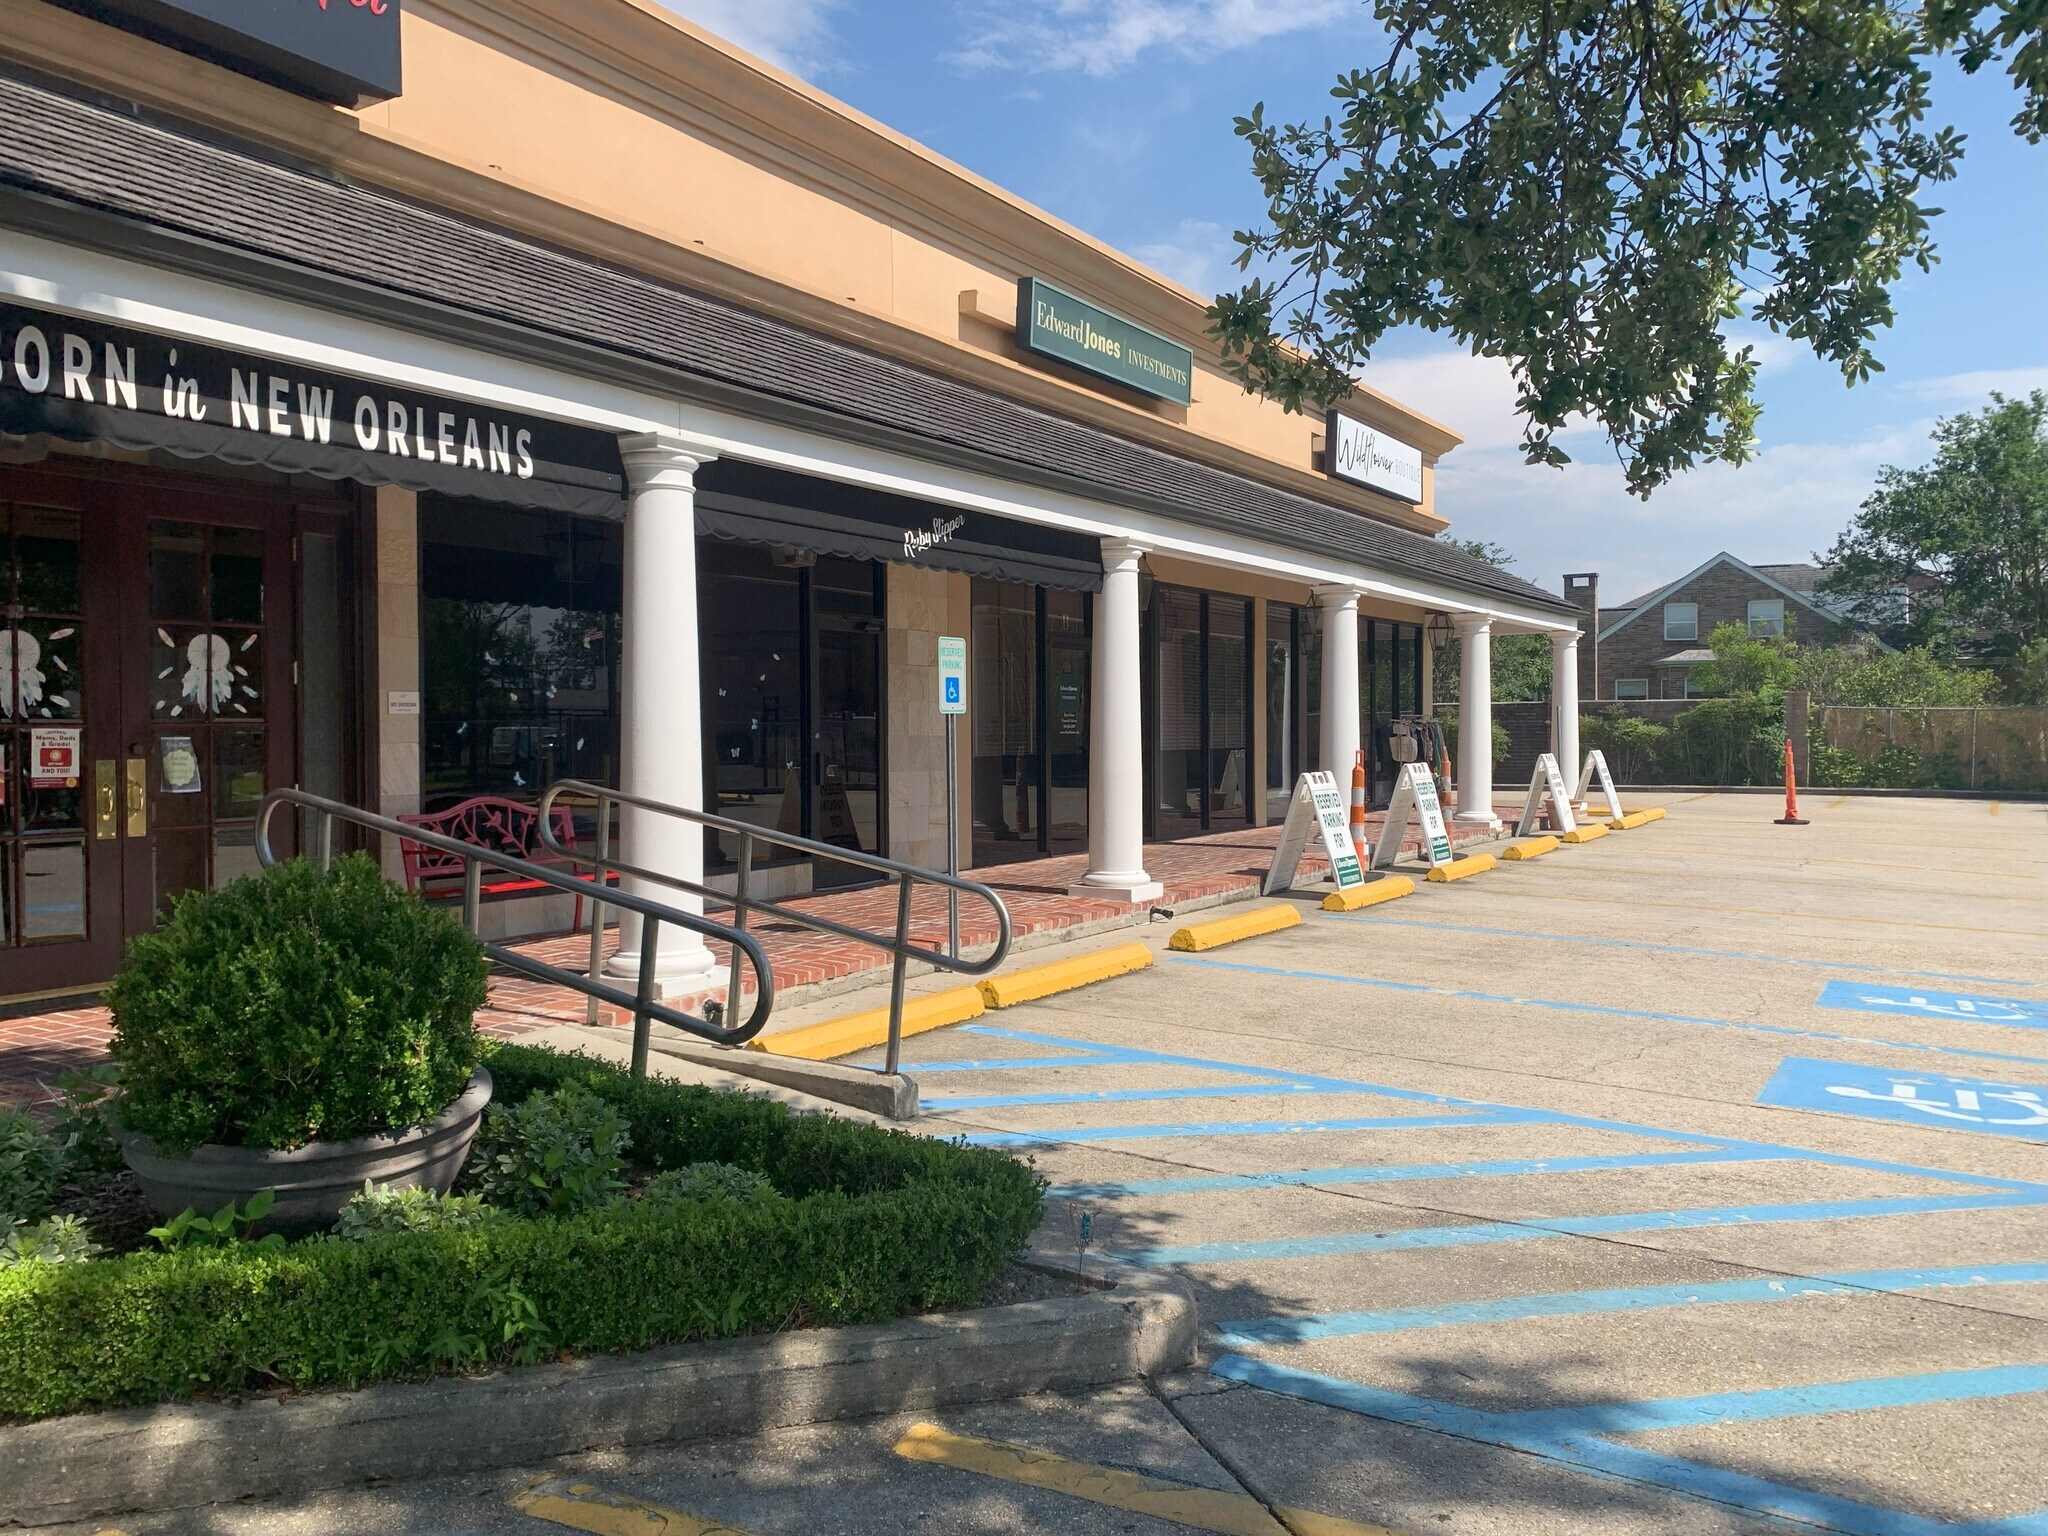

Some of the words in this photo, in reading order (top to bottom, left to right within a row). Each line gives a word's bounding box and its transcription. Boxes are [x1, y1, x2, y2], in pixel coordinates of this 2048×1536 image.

[1128, 348, 1187, 386] INVESTMENTS
[0, 325, 138, 411] ORN
[163, 348, 206, 422] in
[230, 368, 334, 444] NEW
[353, 395, 534, 480] ORLEANS
[1337, 419, 1394, 477] Wildflower
[903, 527, 932, 558] Ruby
[932, 514, 966, 543] Slipper
[940, 646, 965, 658] RESERVED
[942, 659, 963, 671] PARKING
[1415, 781, 1435, 795] RESERVED
[1315, 793, 1341, 809] RESERVED
[1421, 798, 1439, 812] PARKING
[1322, 812, 1345, 829] PARKING
[1429, 816, 1438, 829] FOR
[1333, 833, 1345, 848] FOR
